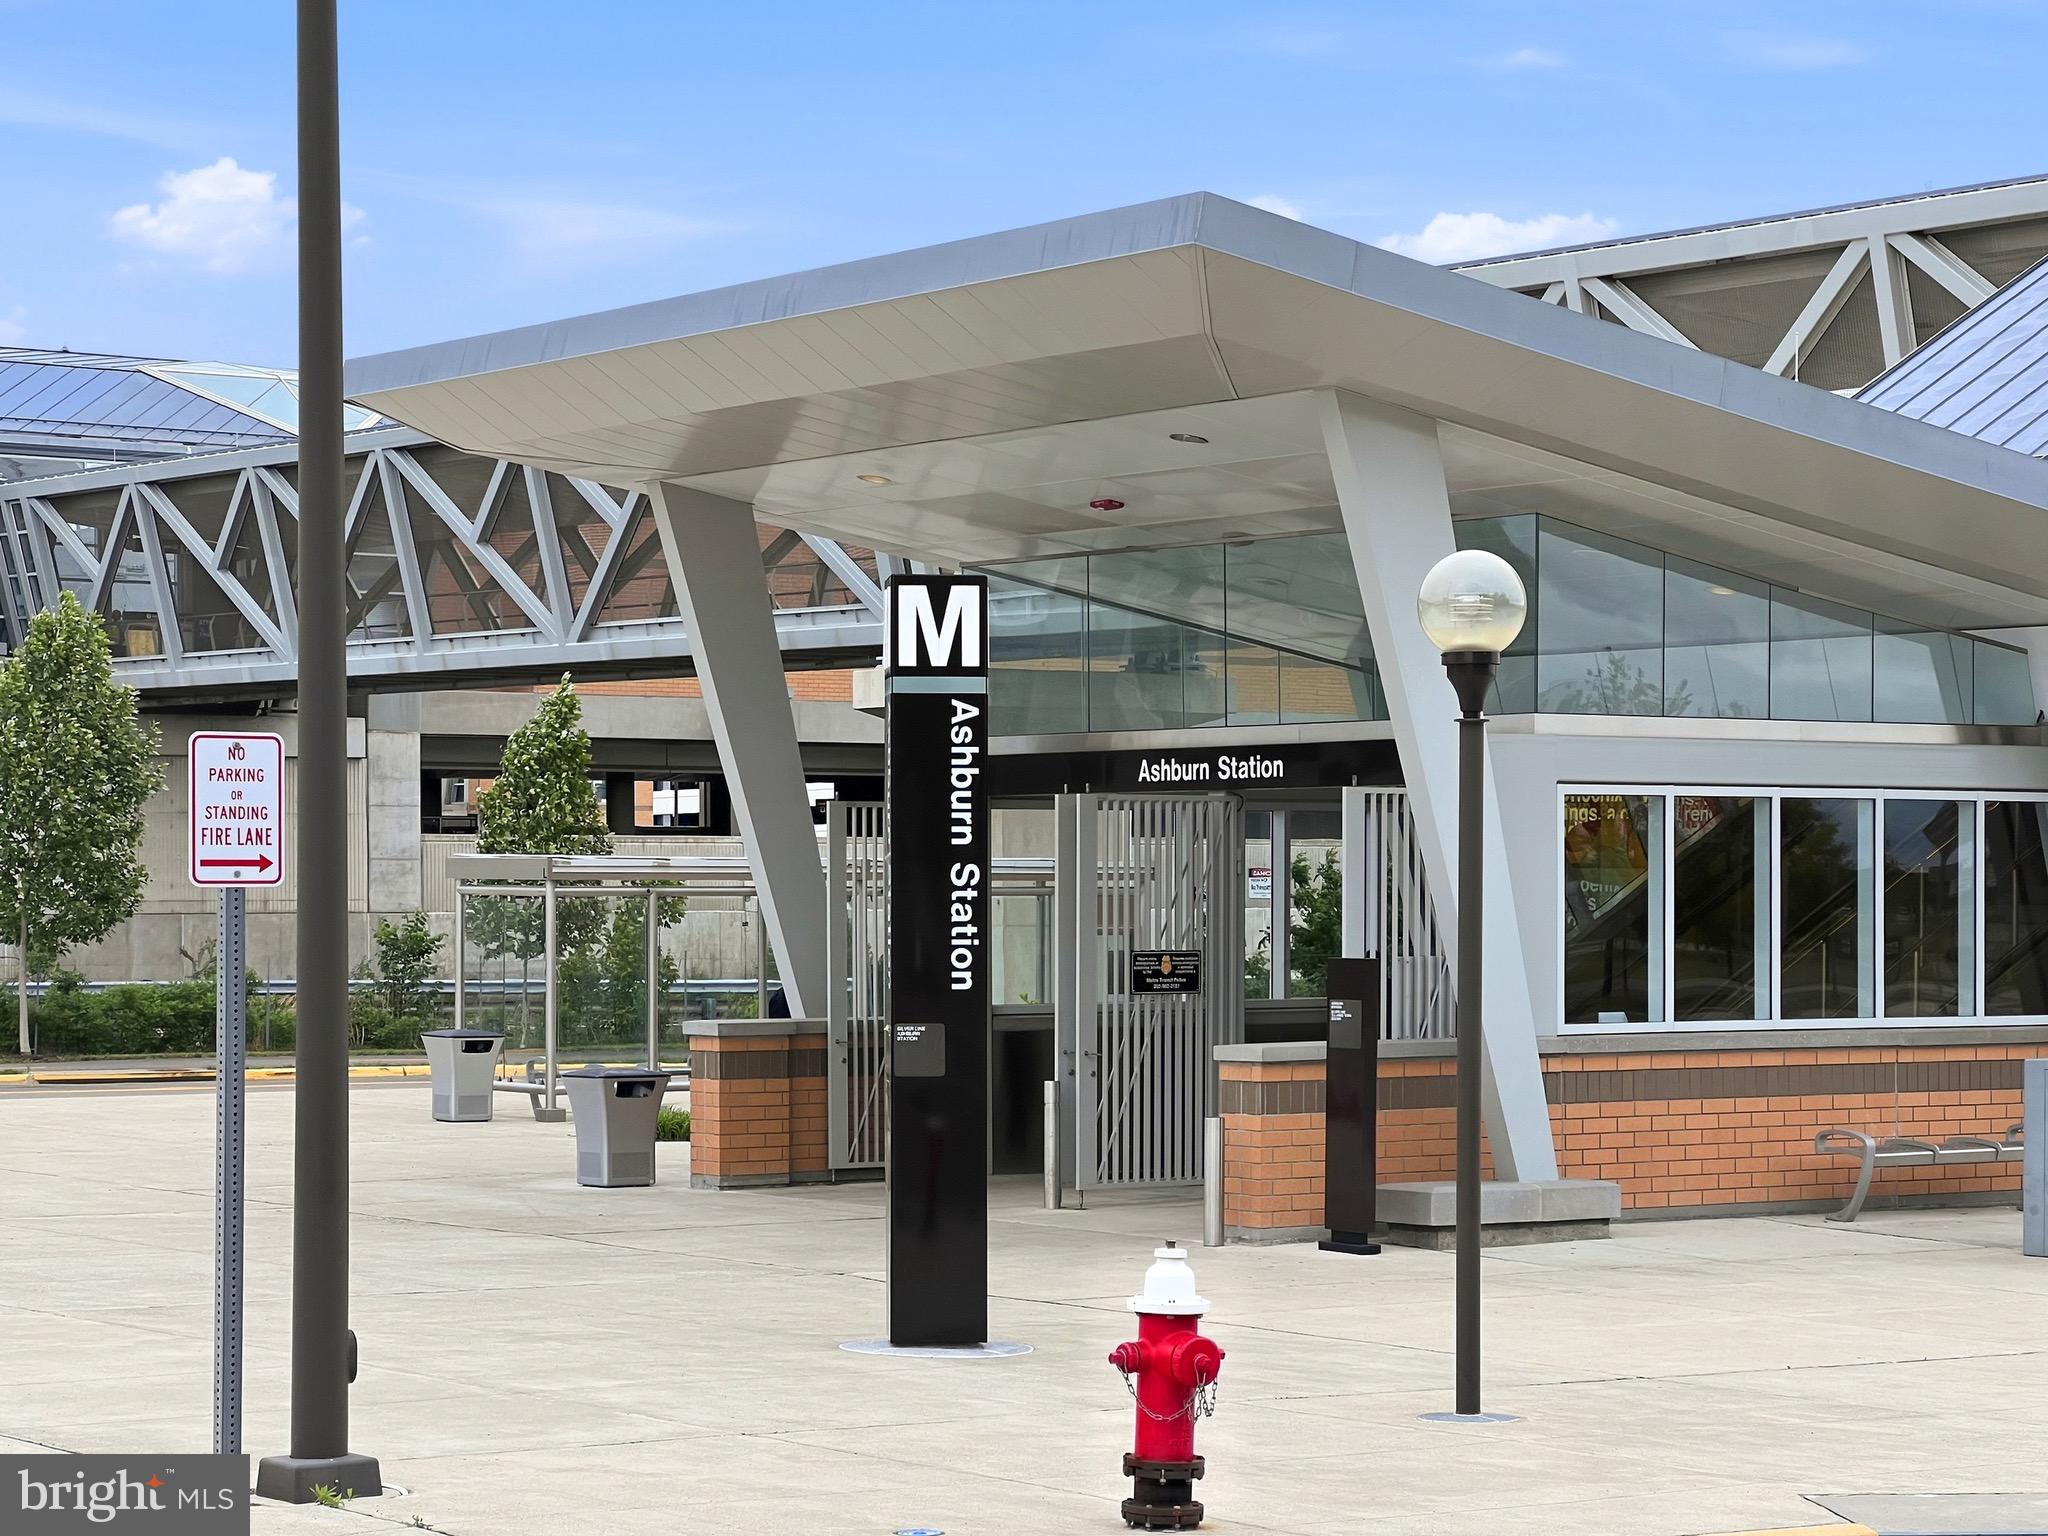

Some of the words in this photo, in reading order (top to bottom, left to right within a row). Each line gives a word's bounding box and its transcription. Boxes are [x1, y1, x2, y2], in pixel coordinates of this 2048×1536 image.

[898, 585, 980, 667] M
[228, 747, 245, 761] NO
[209, 768, 265, 782] PARKING
[950, 698, 980, 845] Ashburn
[1138, 758, 1210, 782] Ashburn
[1217, 755, 1284, 780] Station
[231, 790, 243, 800] OR
[205, 806, 268, 820] STANDING
[201, 827, 232, 846] FIRE
[237, 827, 273, 846] LANE
[950, 862, 980, 990] Station
